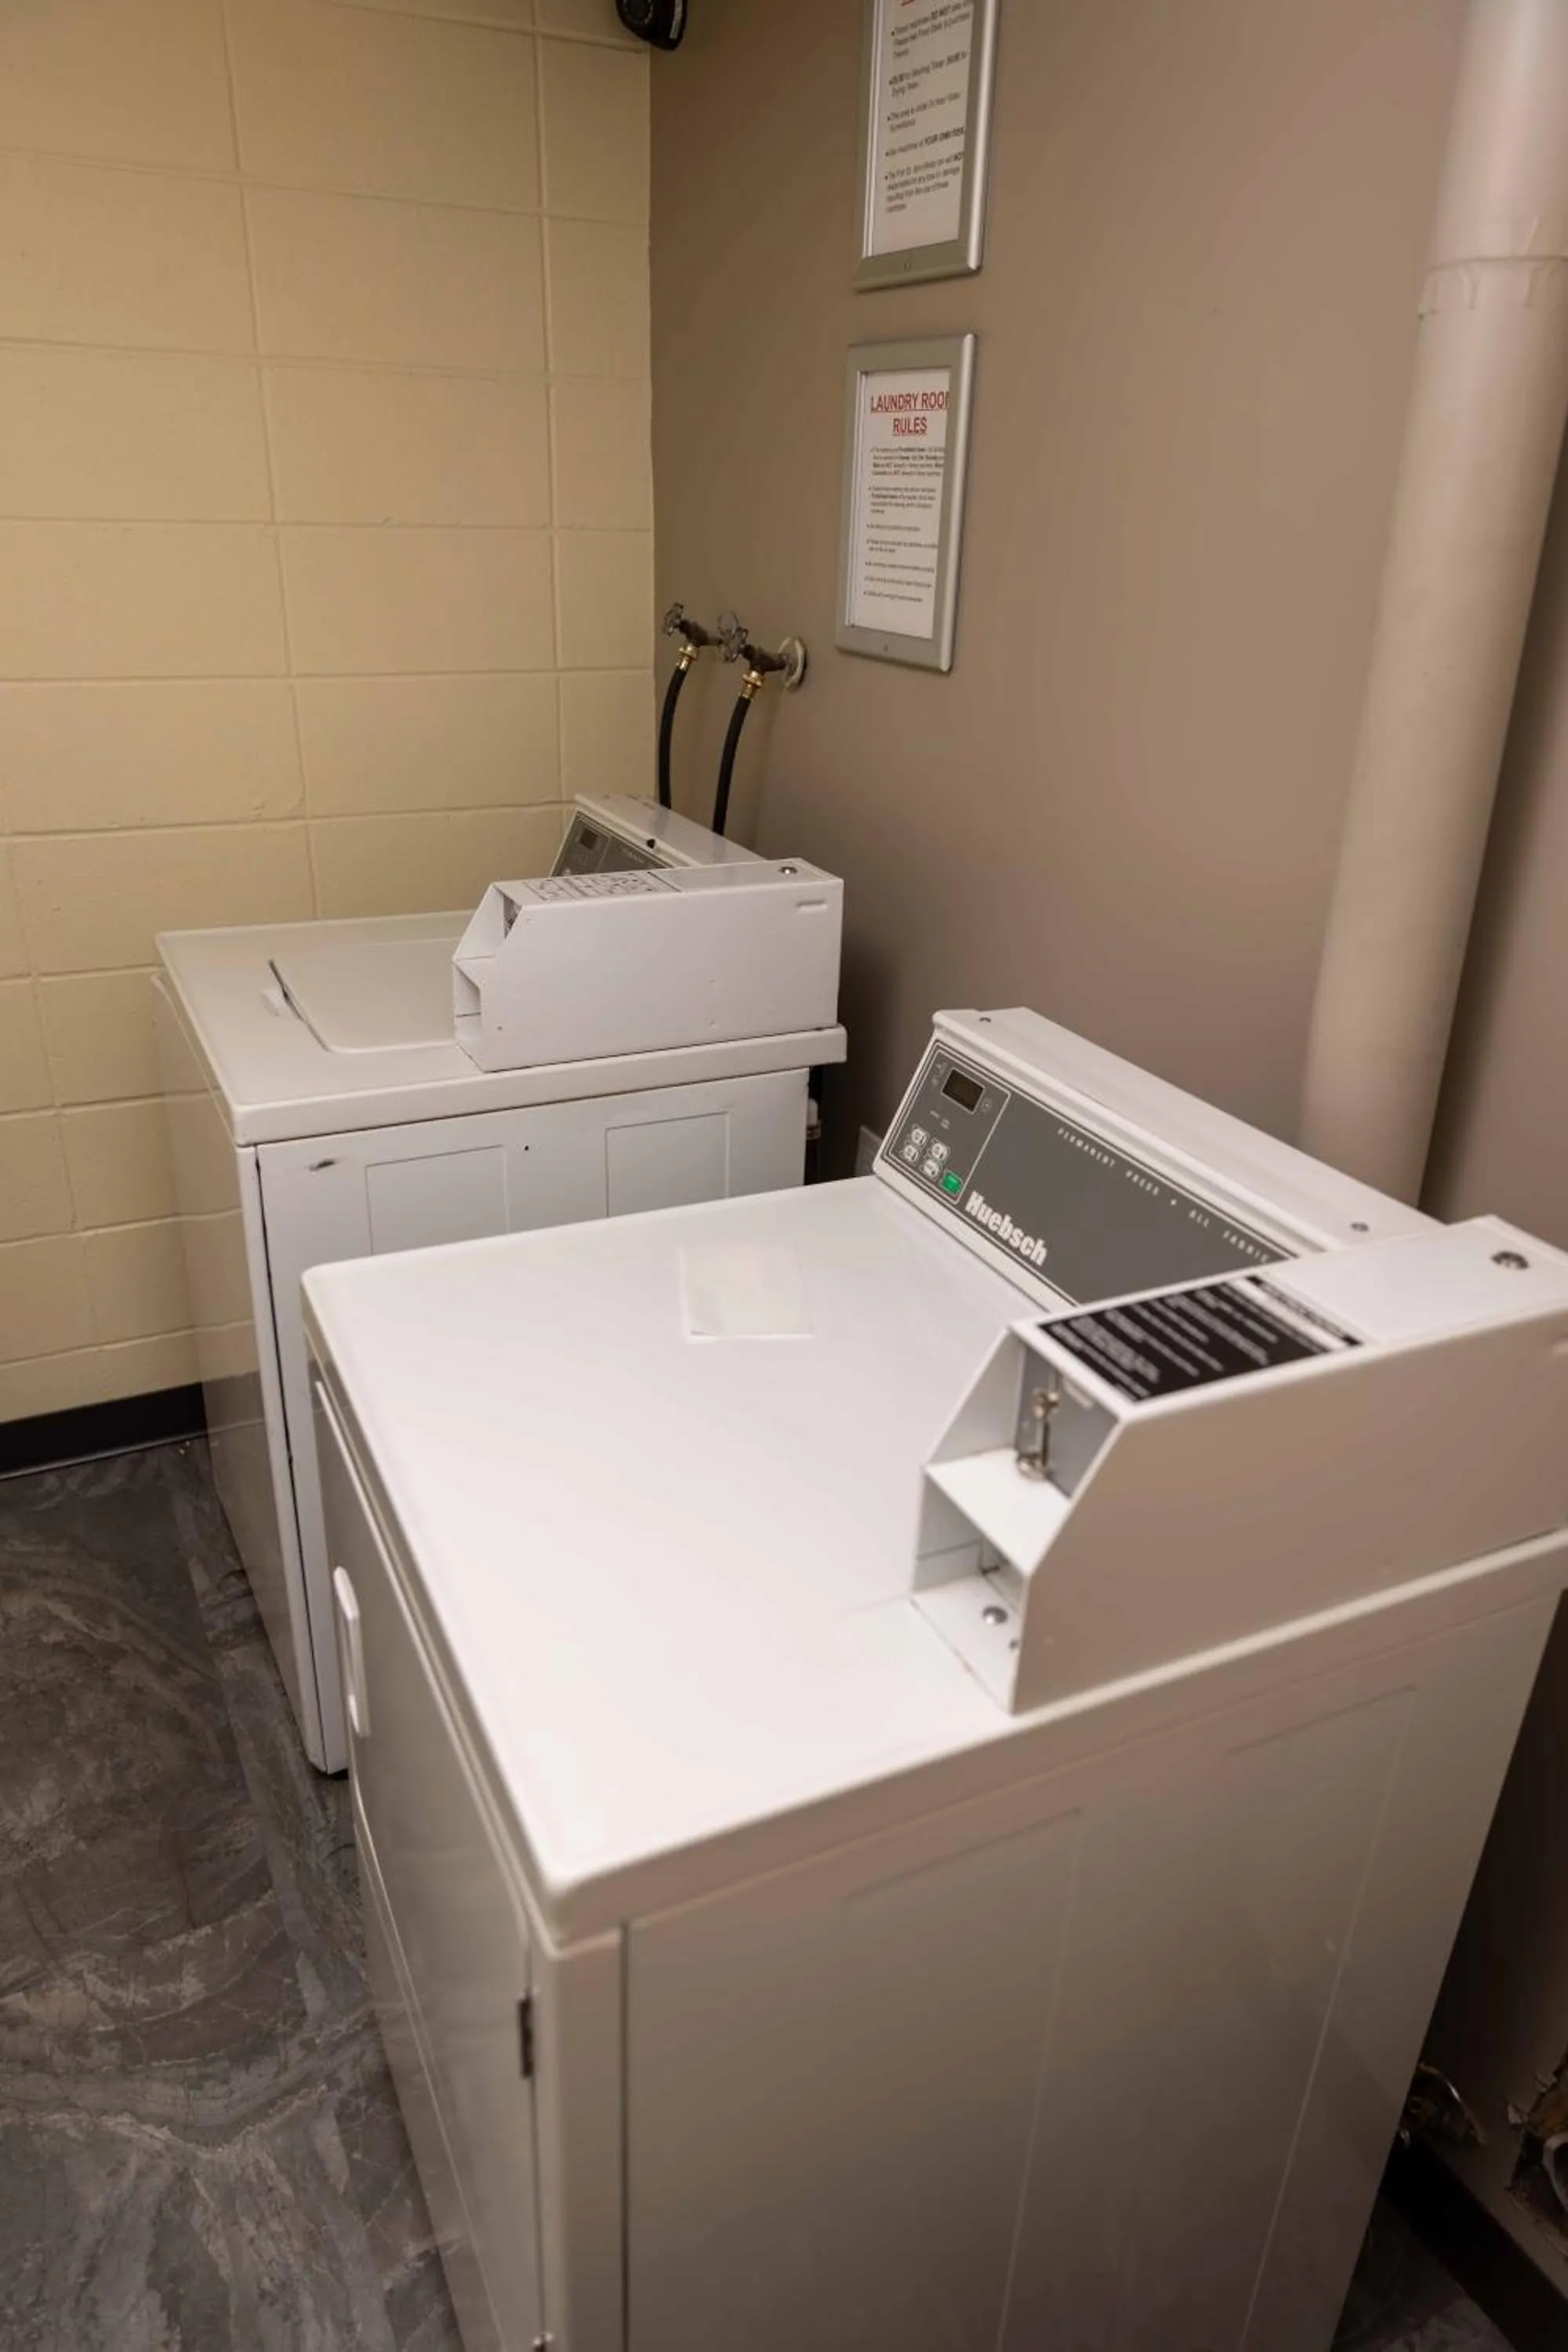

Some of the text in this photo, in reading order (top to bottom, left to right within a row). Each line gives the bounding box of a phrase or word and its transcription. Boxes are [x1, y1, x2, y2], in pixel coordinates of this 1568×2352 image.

[871, 390, 949, 412] LAUNDRY ROO
[893, 417, 927, 434] RULES
[1057, 1127, 1116, 1168] PERMANENT
[965, 1189, 1048, 1267] Huebsch
